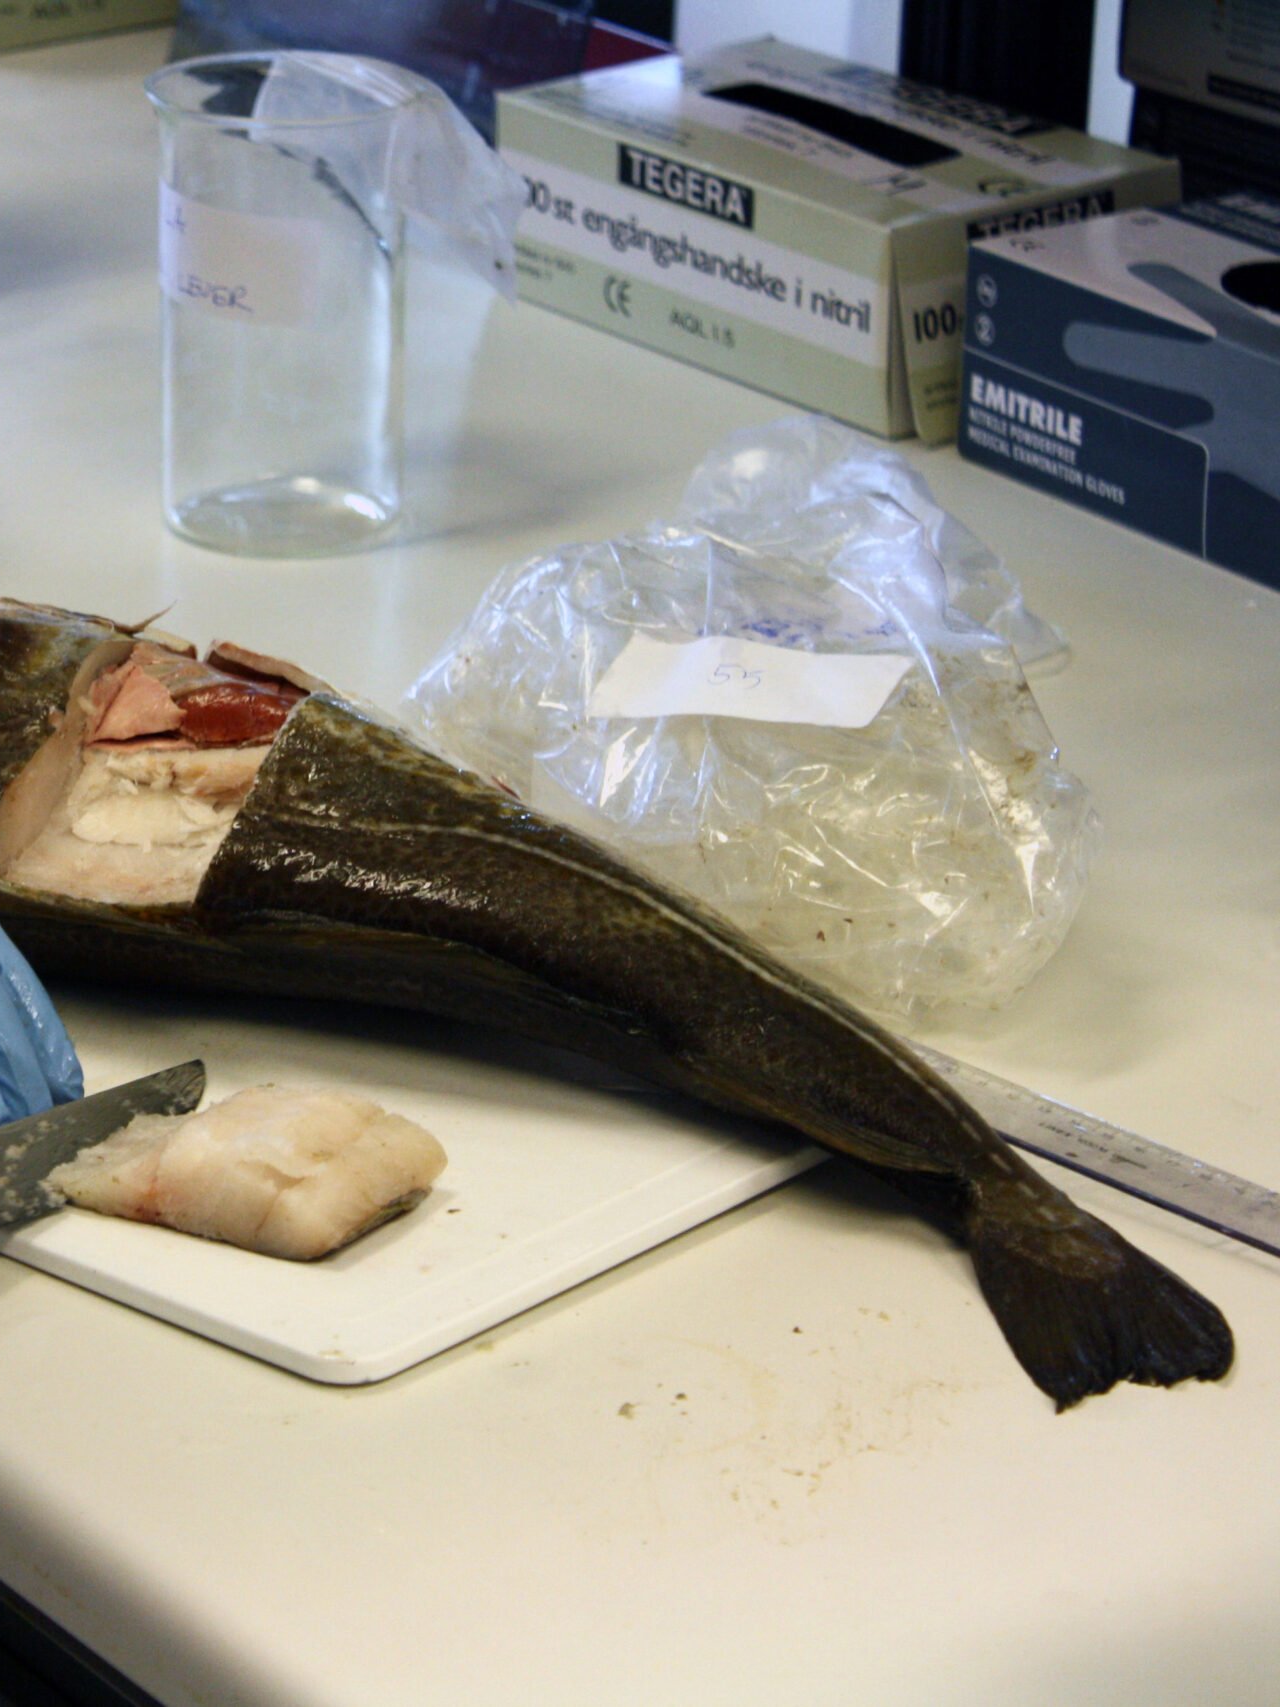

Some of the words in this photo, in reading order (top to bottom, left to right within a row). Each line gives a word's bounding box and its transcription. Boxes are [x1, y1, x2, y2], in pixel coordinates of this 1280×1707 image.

[625, 149, 750, 224] TEGERA
[553, 196, 577, 226] st
[582, 208, 787, 302] engångshandske
[795, 278, 804, 308] i
[811, 290, 870, 334] nitril
[913, 302, 958, 345] 100
[968, 406, 1008, 436] NITRILE
[1009, 423, 1077, 466] POWDERFREE
[970, 373, 1083, 447] EMITRILE
[967, 425, 1011, 458] MEDICAL
[1013, 445, 1083, 489] EXAMINATION
[1085, 474, 1126, 506] GLOVES
